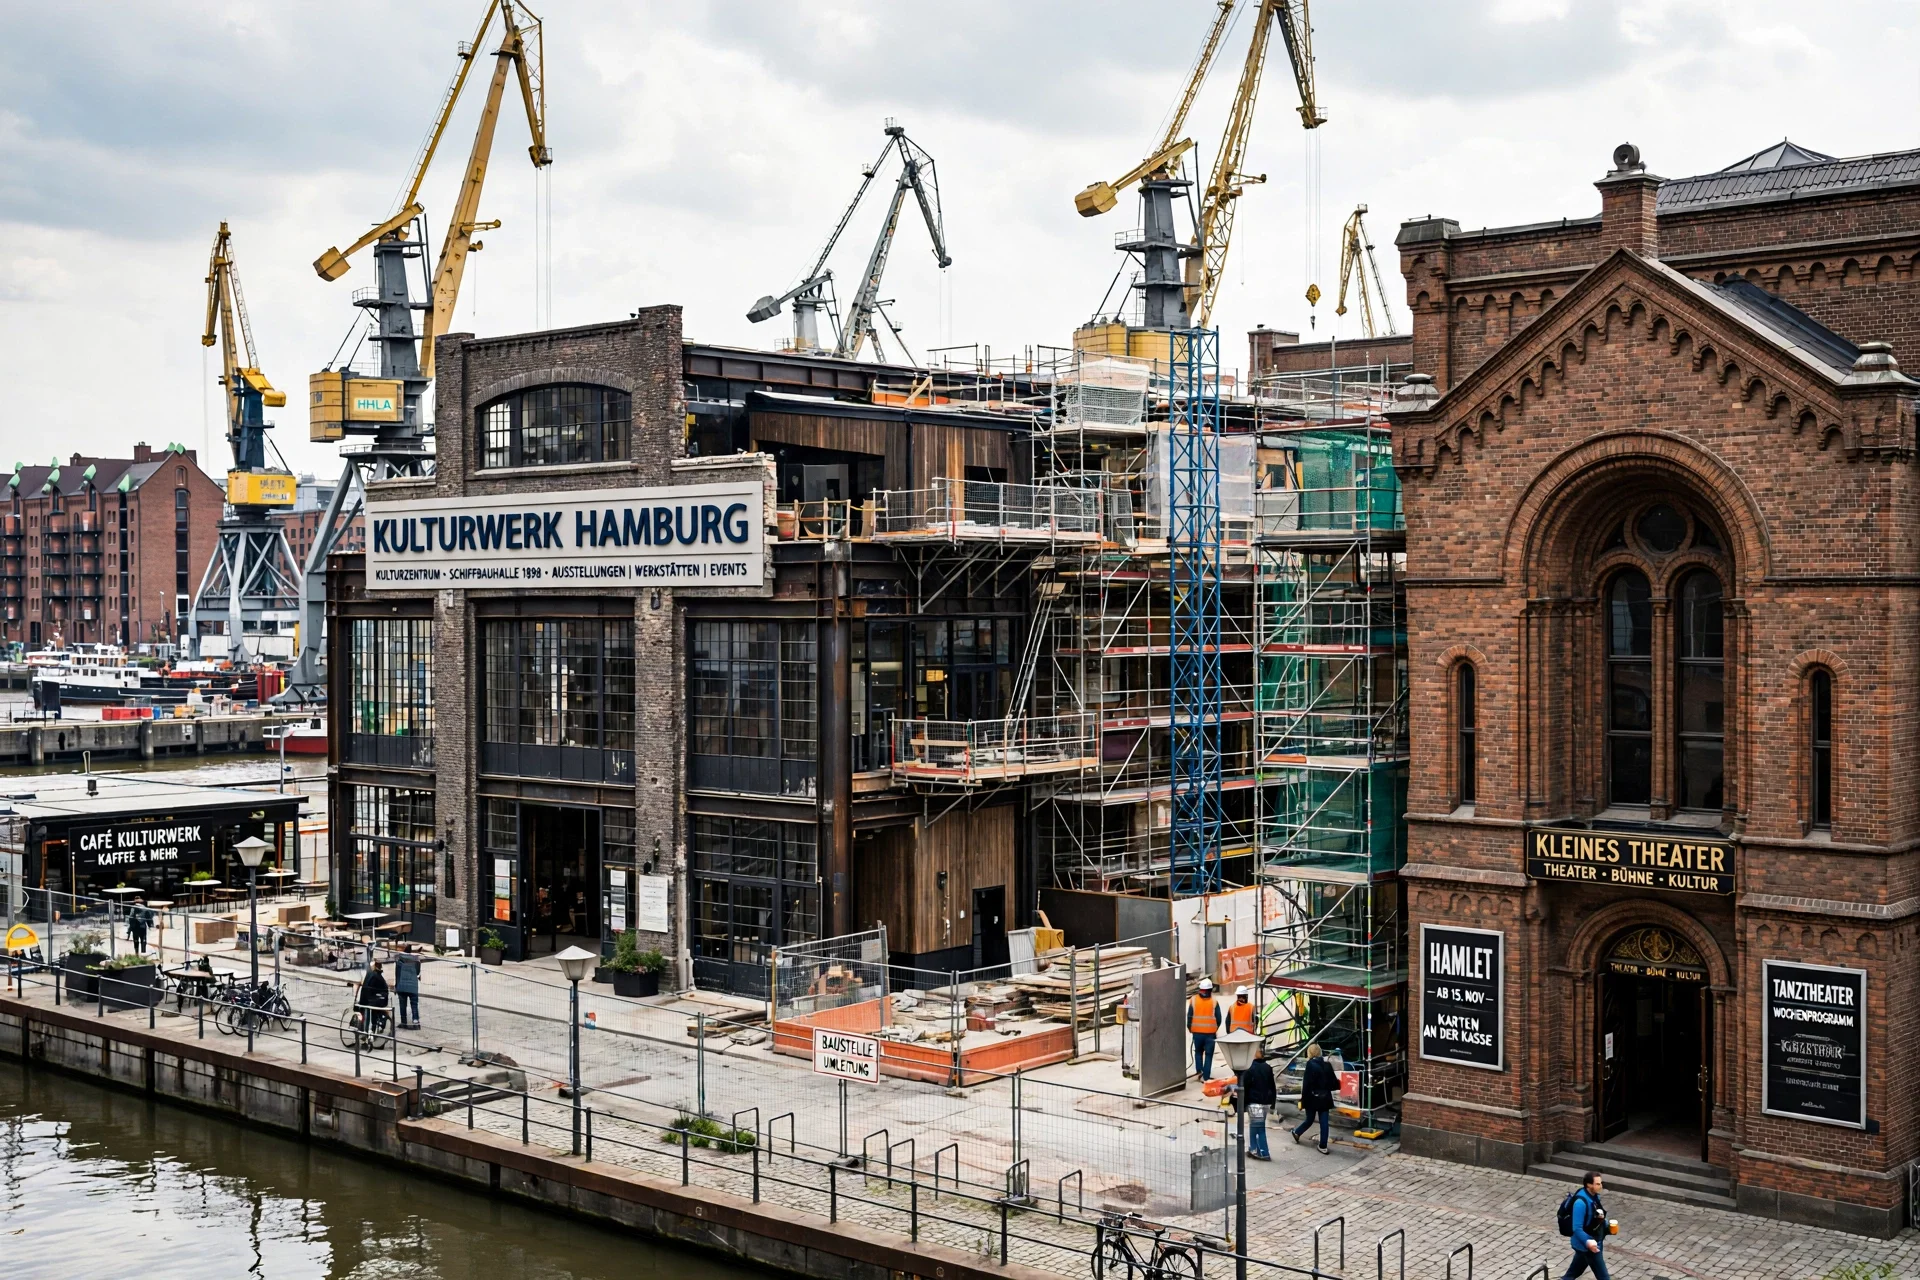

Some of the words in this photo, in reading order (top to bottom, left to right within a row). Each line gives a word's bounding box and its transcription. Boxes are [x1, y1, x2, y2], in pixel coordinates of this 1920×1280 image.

[357, 399, 392, 410] HHLA
[373, 511, 563, 553] KULTURWERK
[575, 503, 749, 546] HAMBURG
[375, 569, 441, 580] KULTURZENTRUM
[551, 565, 626, 578] AUSSTELLUNGEN
[634, 562, 700, 577] WERKSTÄTTEN
[710, 563, 747, 576] EVENTS
[80, 829, 113, 850] CAFÉ
[117, 825, 201, 848] KULTURWERK
[139, 850, 147, 862] &
[150, 847, 178, 861] MEHR
[1536, 834, 1620, 863] KLEINES
[1628, 840, 1725, 872] THEATER
[1543, 863, 1597, 880] THEATER
[1611, 867, 1654, 885] BÜHNE
[1668, 874, 1719, 891] KULTUR
[1430, 942, 1493, 980] HAMLET
[1436, 986, 1449, 999] AB
[1451, 988, 1464, 1002] 15.
[1465, 989, 1485, 1004] NOV
[1773, 979, 1854, 1006] TANZTHEATER
[1437, 1013, 1480, 1032] KARTEN
[1773, 1006, 1854, 1027] WOCHENPROGRAMM
[822, 1035, 874, 1058] BAUSTELLE
[1423, 1024, 1437, 1038] AN
[1439, 1027, 1459, 1041] DER
[1461, 1031, 1493, 1047] KASSE
